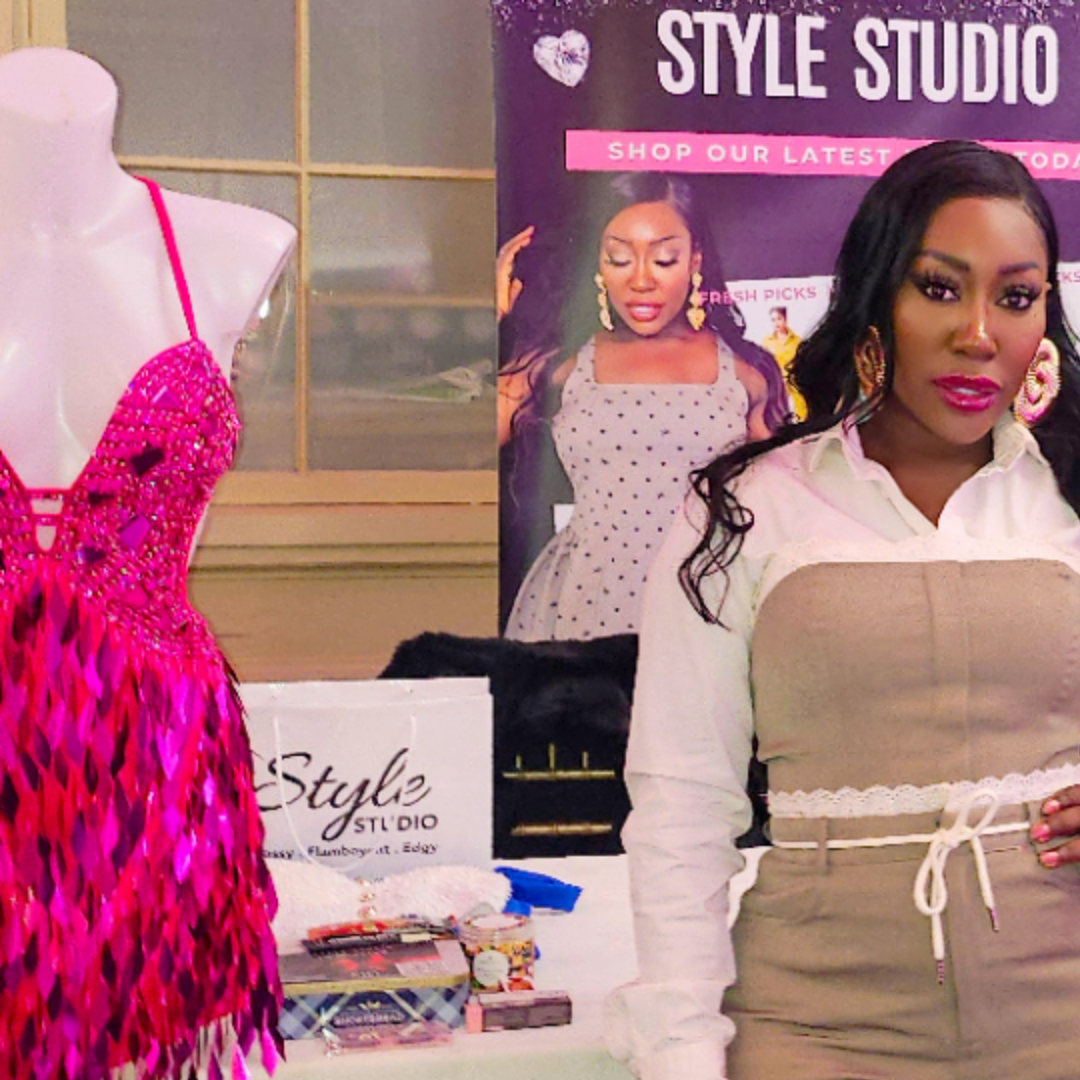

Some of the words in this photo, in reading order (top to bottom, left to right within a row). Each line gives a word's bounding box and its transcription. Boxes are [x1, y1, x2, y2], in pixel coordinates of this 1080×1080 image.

[657, 9, 828, 98] STYLE
[854, 17, 1059, 106] STUDIO
[608, 142, 692, 161] SHOP
[707, 144, 769, 163] OUR
[784, 146, 891, 166] LATEST
[700, 290, 757, 304] FRESH
[763, 286, 818, 300] PICKS
[255, 747, 432, 841] Style
